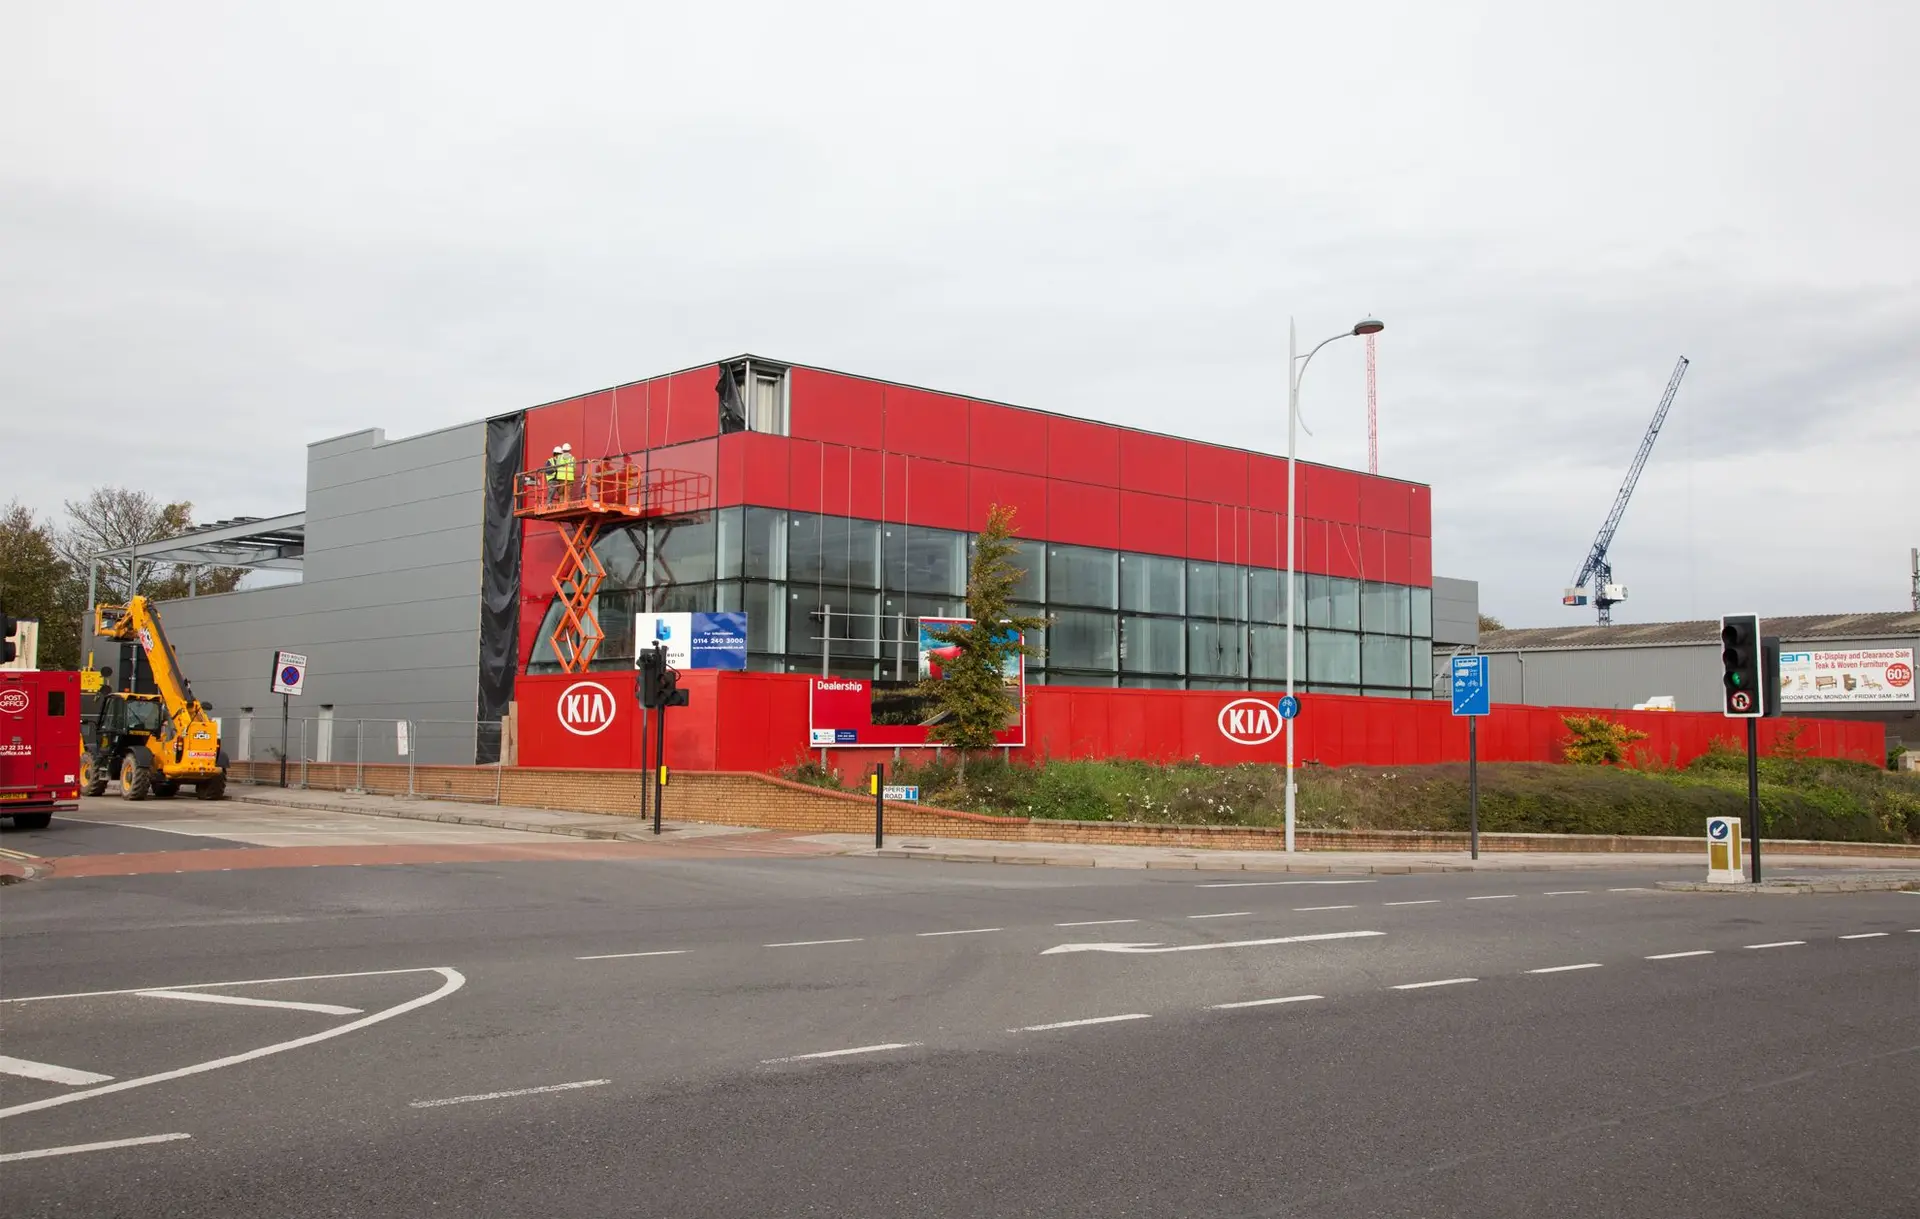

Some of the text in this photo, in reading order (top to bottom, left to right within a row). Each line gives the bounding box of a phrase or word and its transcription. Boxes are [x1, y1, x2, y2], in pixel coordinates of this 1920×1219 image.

[1814, 652, 1847, 661] Ex-Display
[1862, 651, 1894, 659] Clearance
[817, 681, 862, 692] Dealership
[567, 694, 605, 722] KIA
[1229, 709, 1272, 734] KIA
